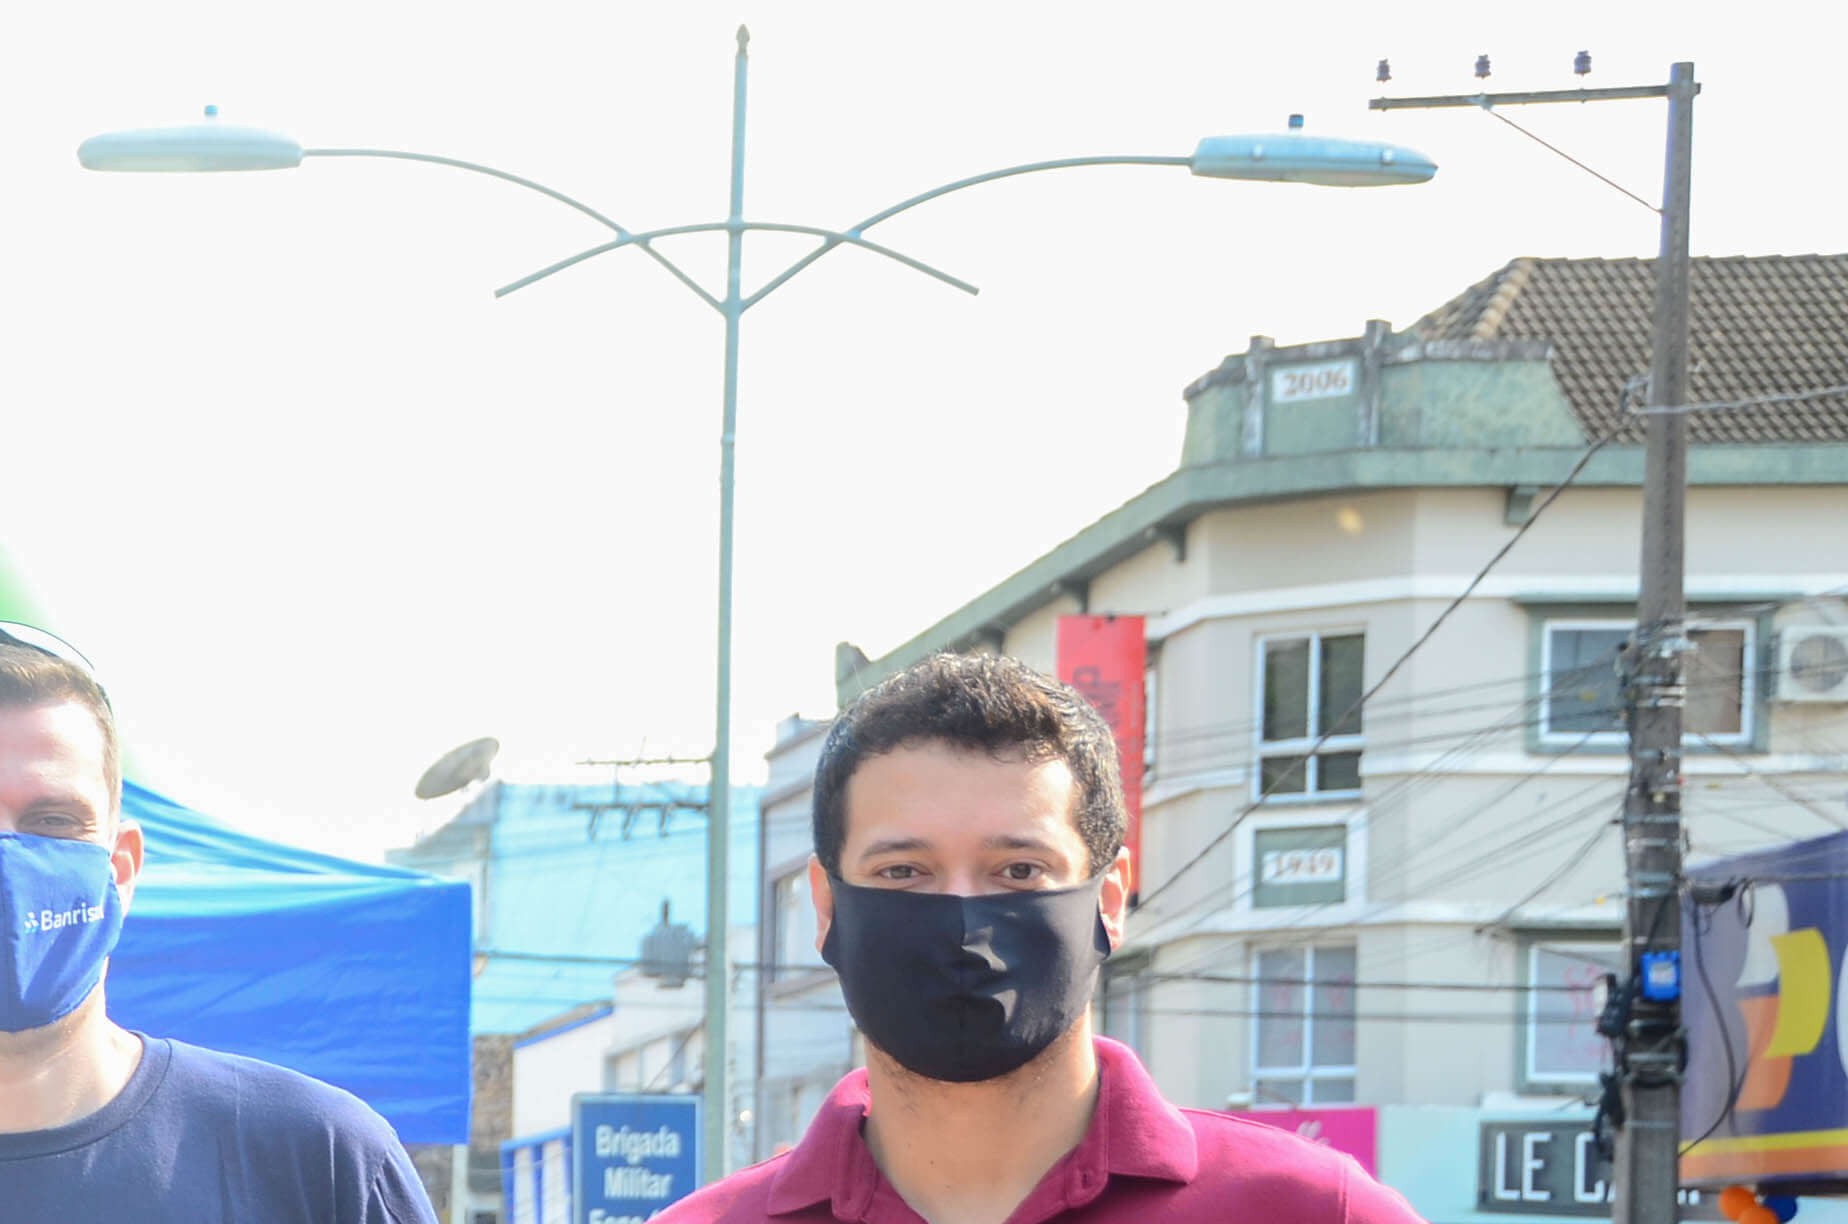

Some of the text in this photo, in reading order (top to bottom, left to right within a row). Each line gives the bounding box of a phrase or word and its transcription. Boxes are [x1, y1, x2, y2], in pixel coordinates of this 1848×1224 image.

[1283, 369, 1348, 395] 2006
[595, 1124, 681, 1165] Brigada
[604, 1166, 673, 1199] Militar
[1495, 1132, 1551, 1201] LE
